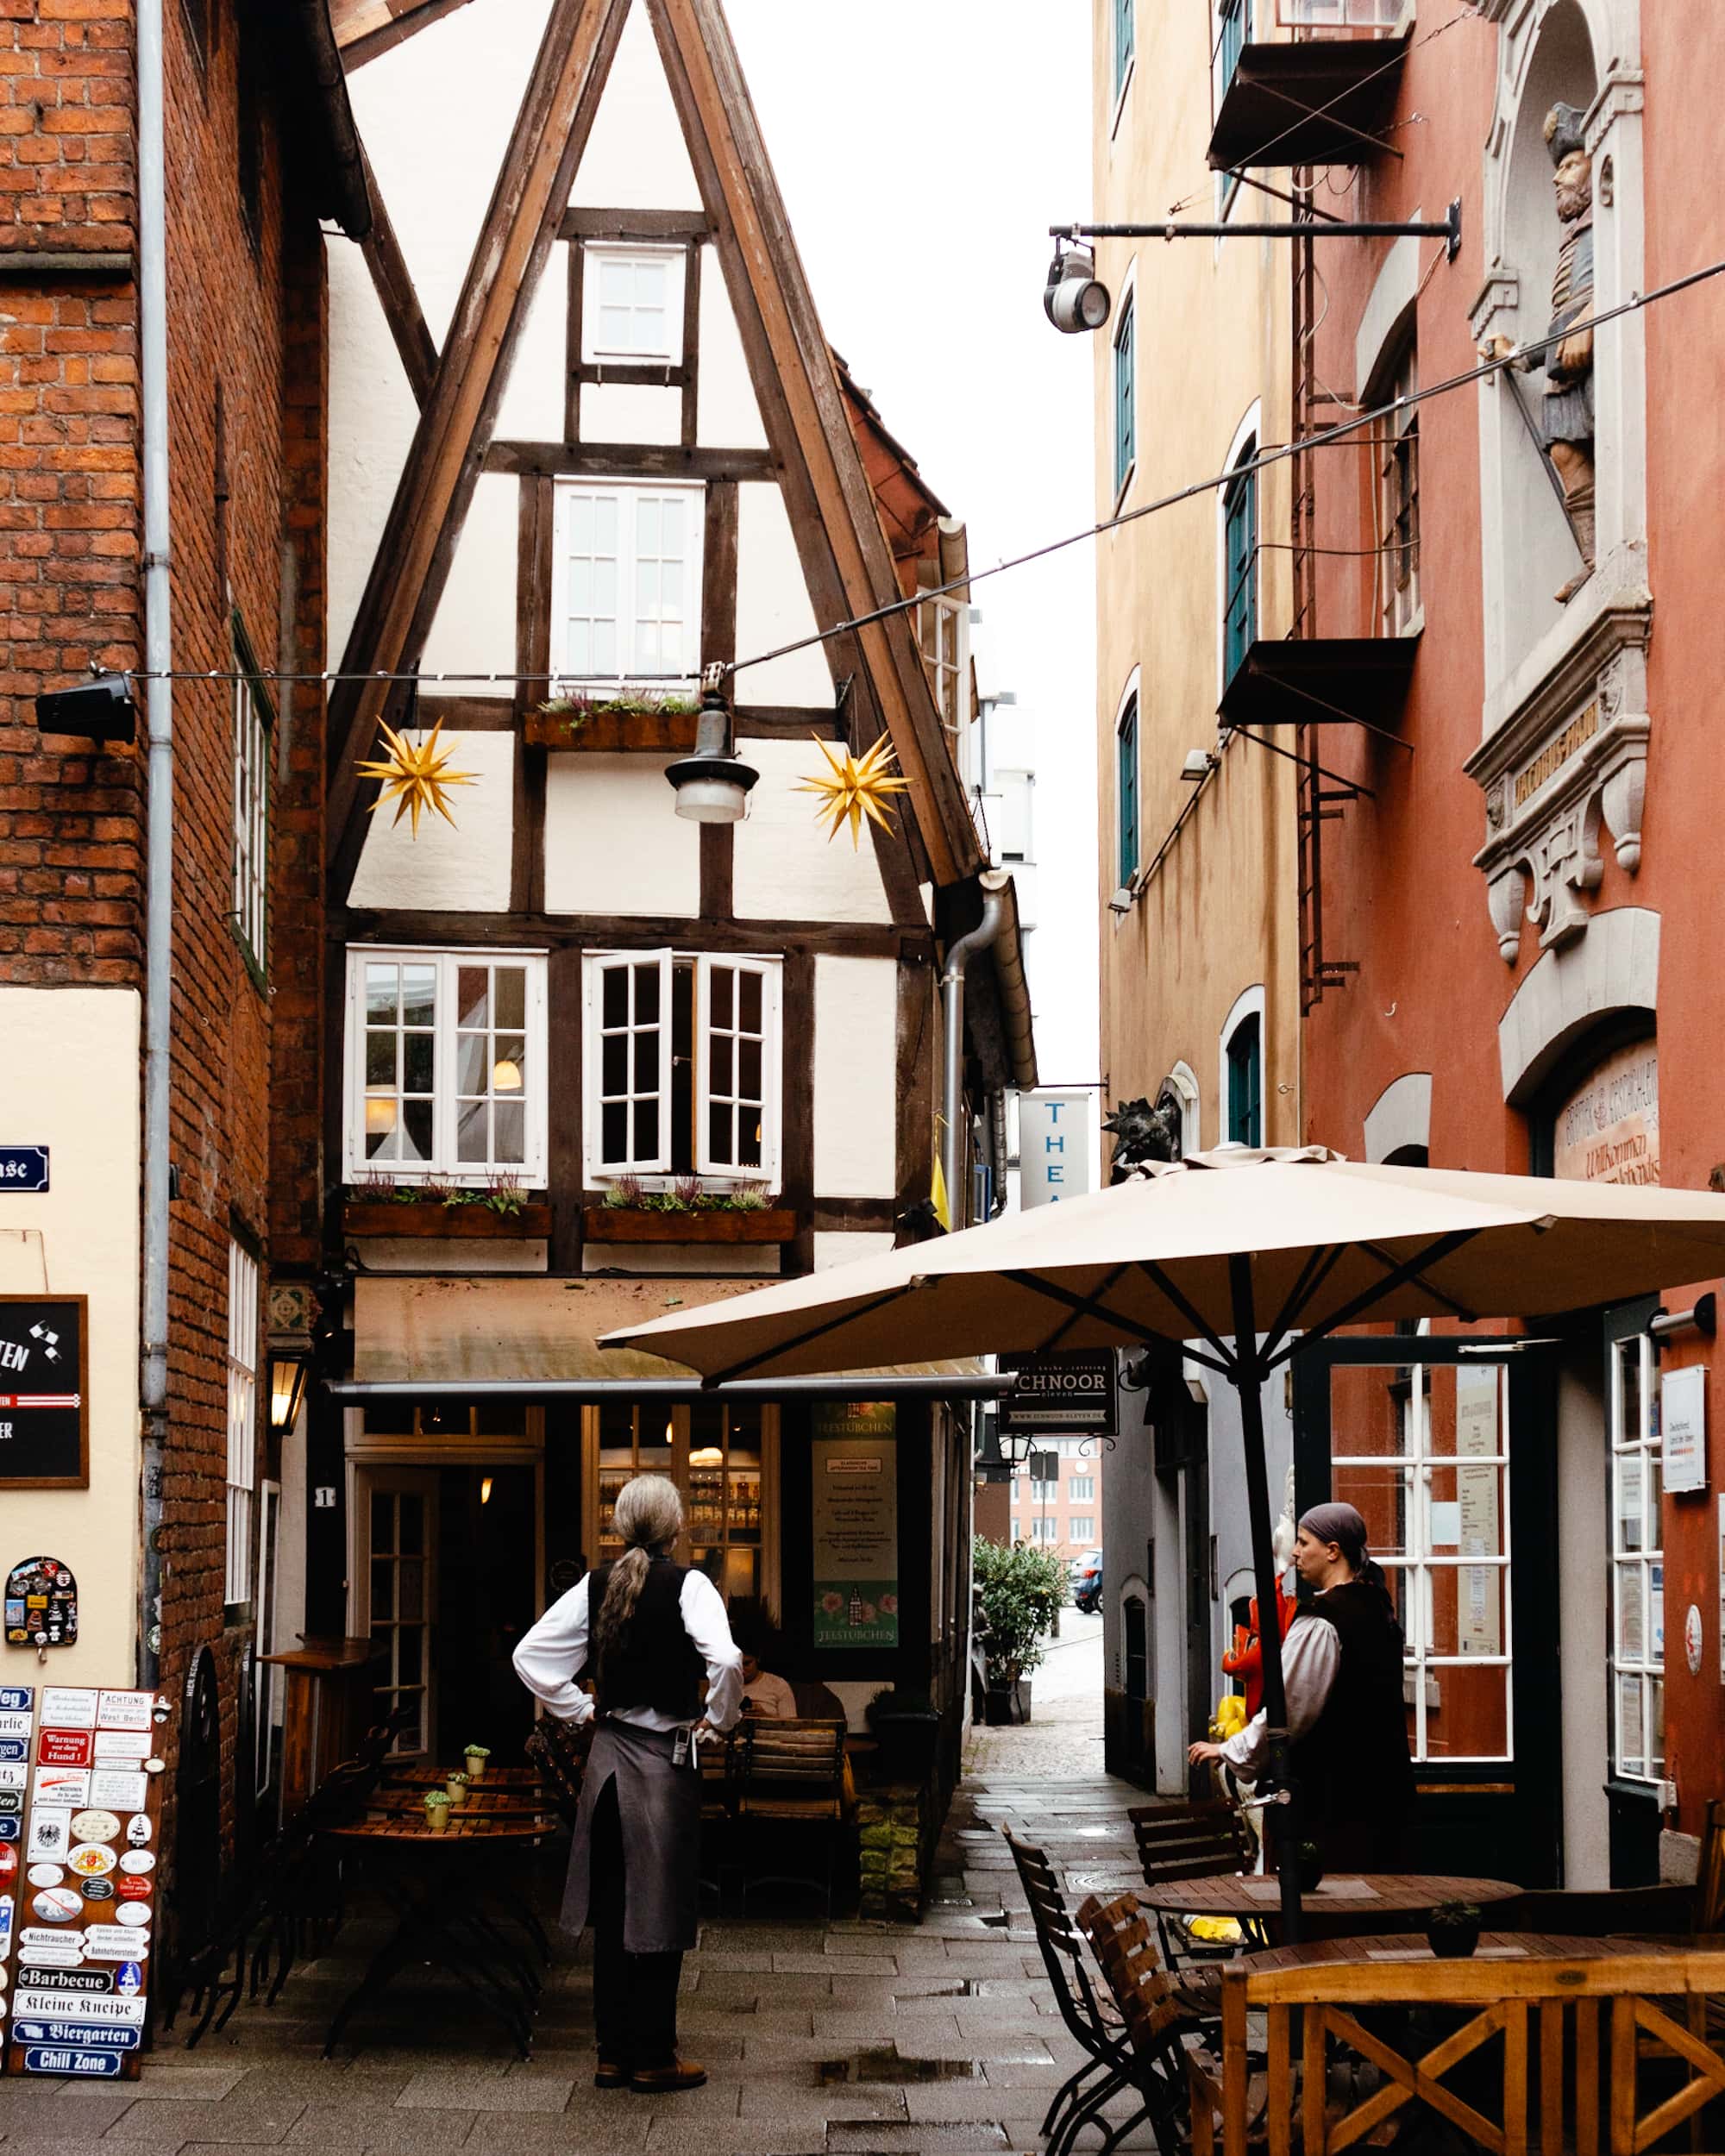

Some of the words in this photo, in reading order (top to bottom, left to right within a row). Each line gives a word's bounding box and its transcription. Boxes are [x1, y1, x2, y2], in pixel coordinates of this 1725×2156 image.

[1015, 1374, 1106, 1390] CHNOOR
[322, 1489, 329, 1506] 1
[104, 1695, 145, 1705] ACHTUNG
[47, 1734, 85, 1746] Warnung
[47, 1752, 76, 1761] Hund
[28, 1932, 76, 1944] Nichtraucher
[29, 1970, 104, 1990] Barbecue
[26, 1996, 74, 2011] Kleine
[79, 1998, 132, 2017] Kneipe
[48, 2024, 130, 2045] Biergarten
[40, 2051, 71, 2070] Chill
[74, 2053, 107, 2071] Zone
